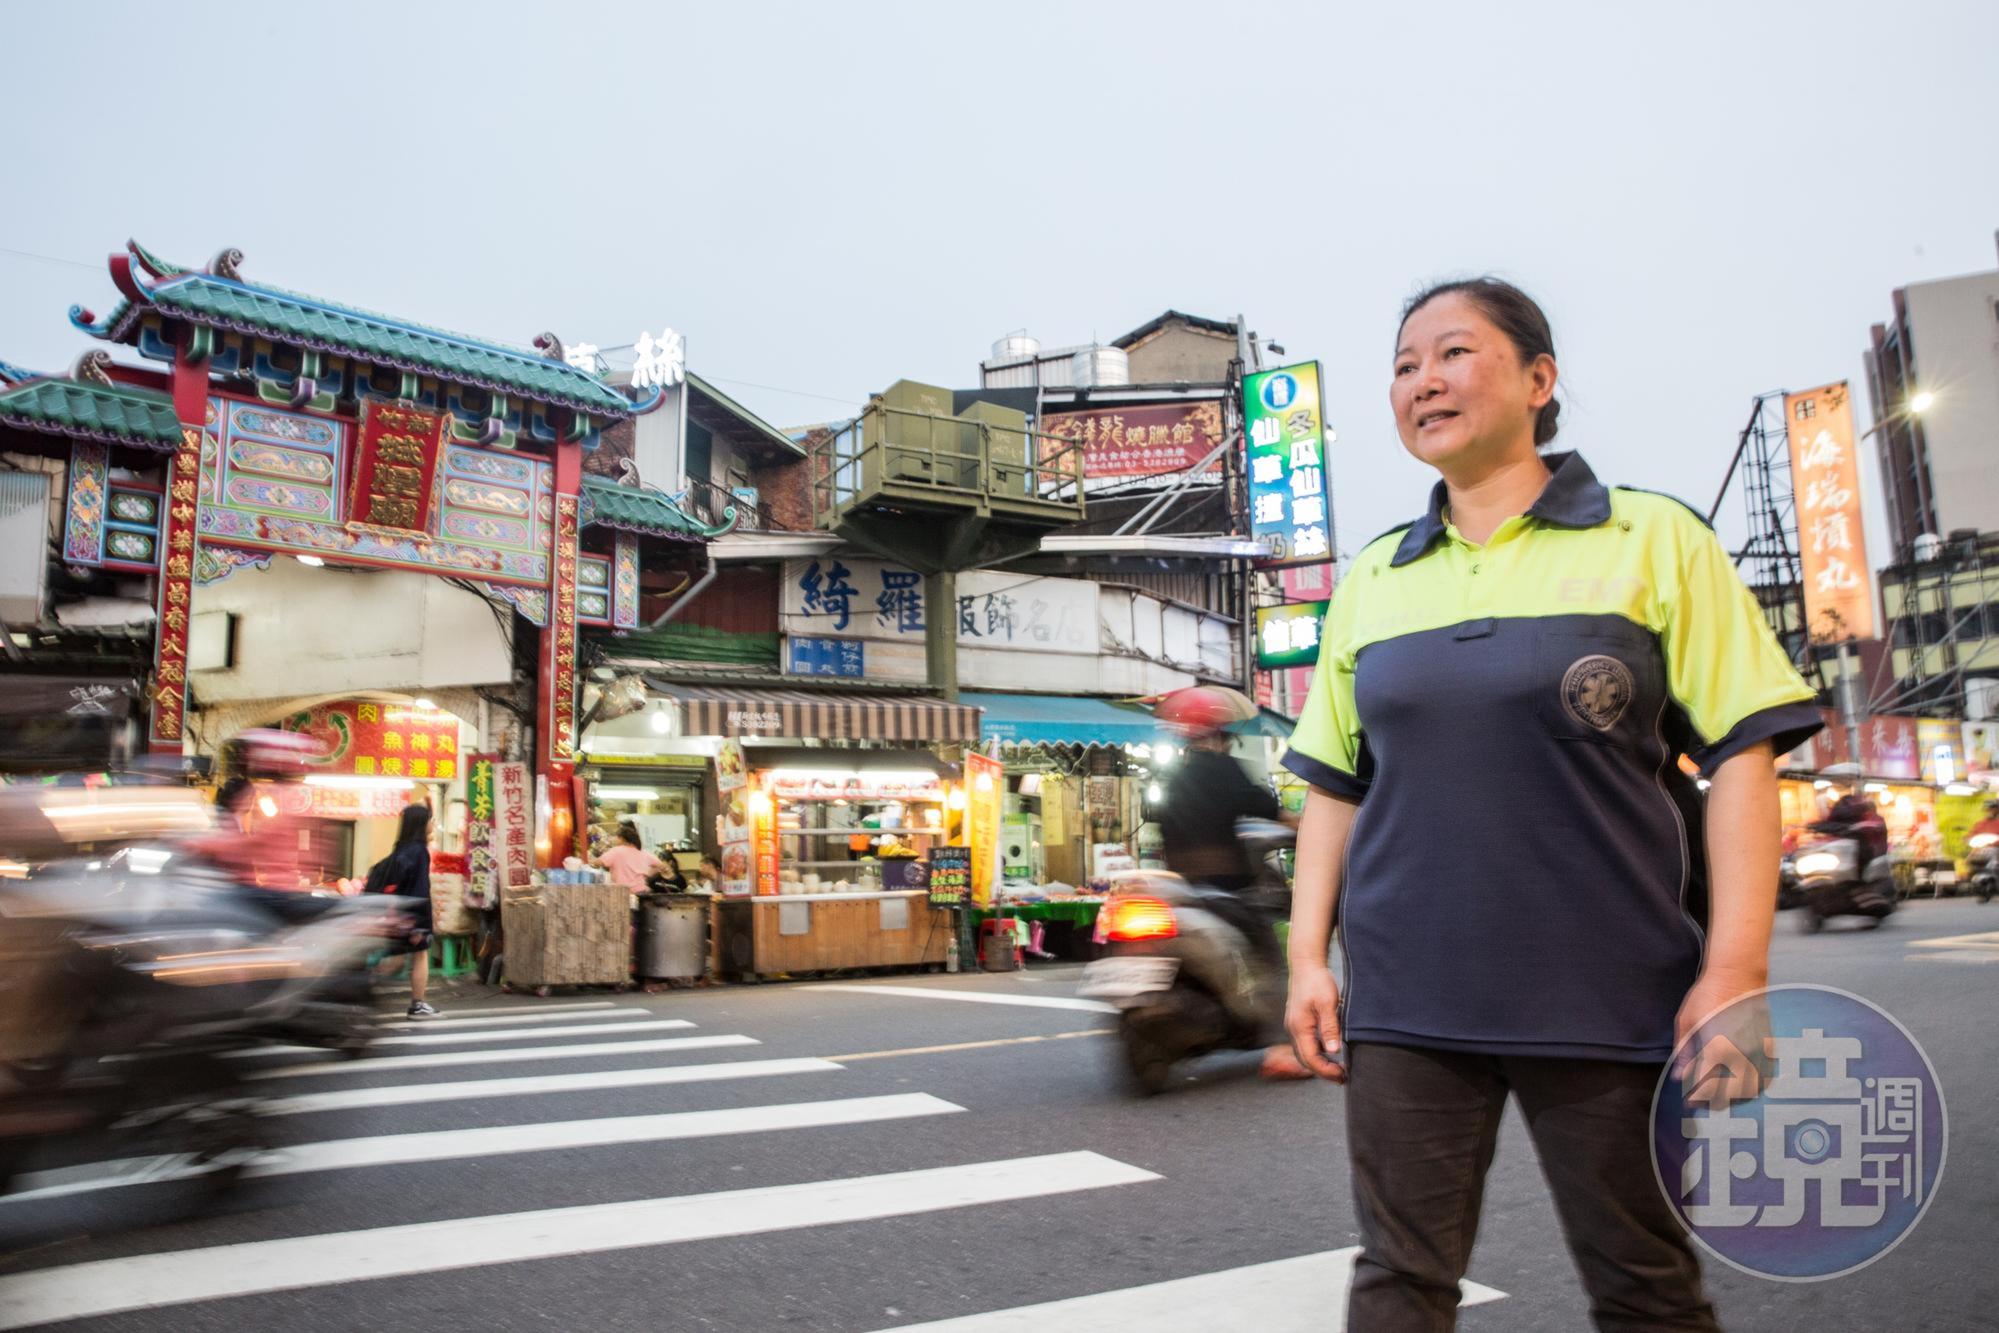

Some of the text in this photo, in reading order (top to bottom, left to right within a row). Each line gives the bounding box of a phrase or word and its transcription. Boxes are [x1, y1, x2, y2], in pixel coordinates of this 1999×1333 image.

[364, 432, 426, 528] 城隍廟
[502, 765, 532, 887] 新竹名產肉圓
